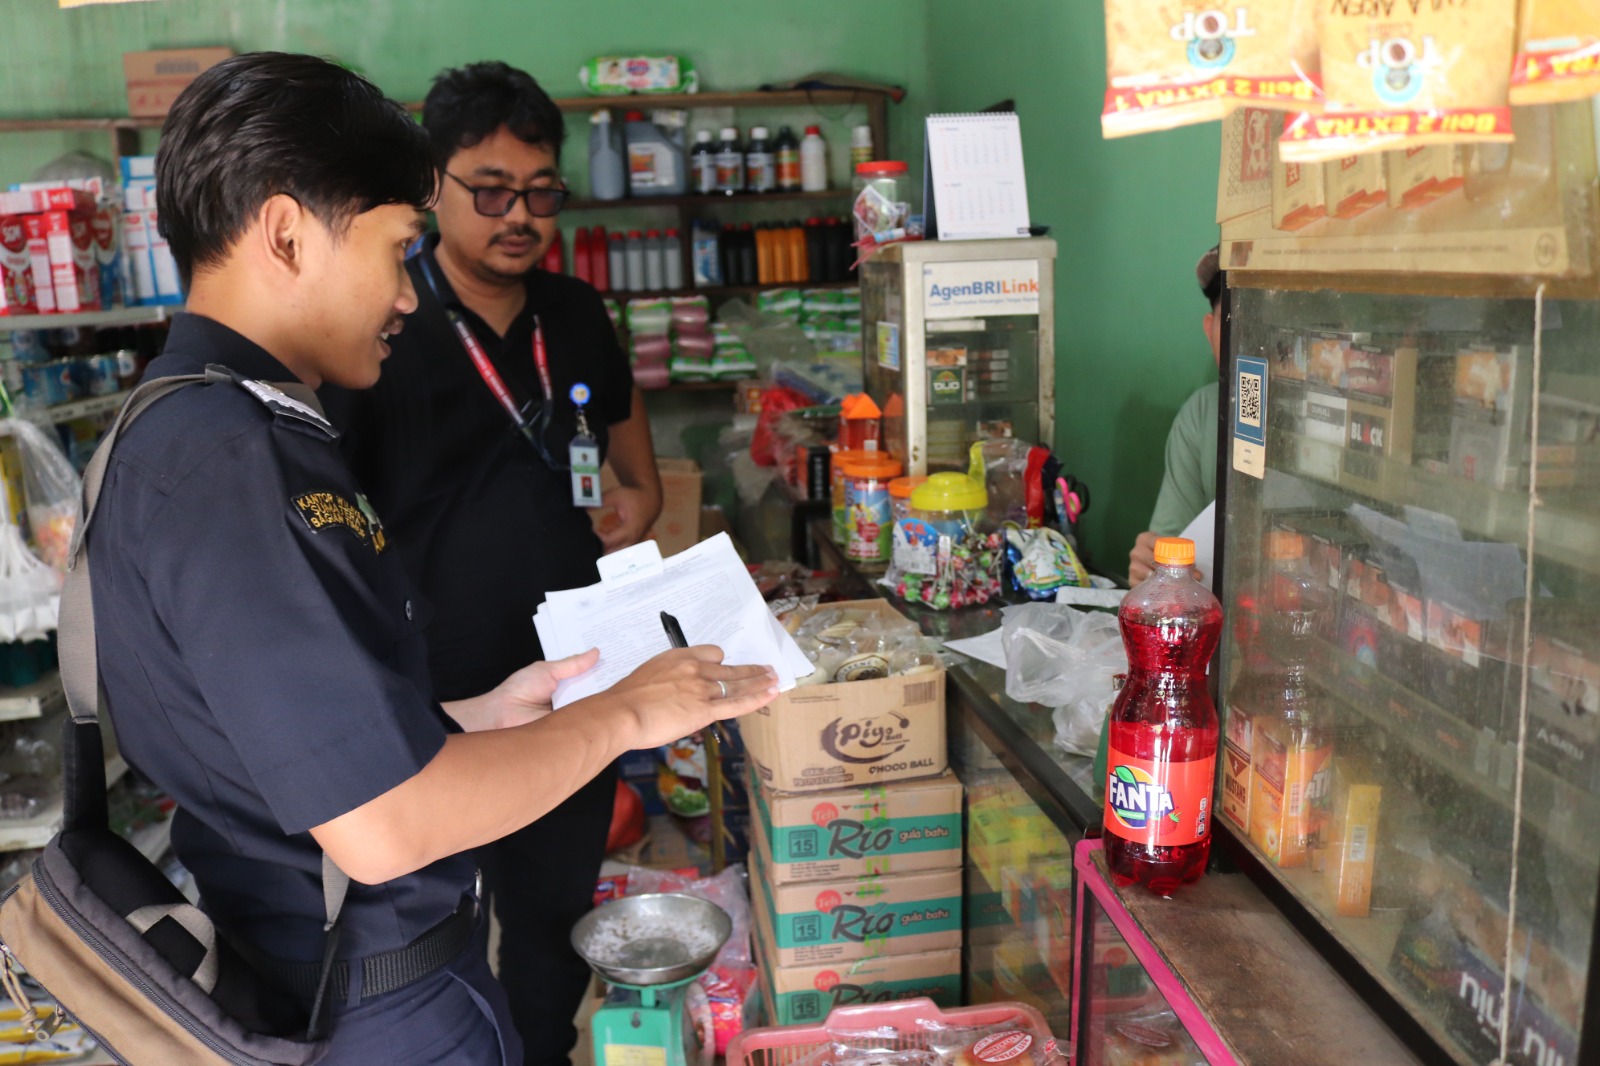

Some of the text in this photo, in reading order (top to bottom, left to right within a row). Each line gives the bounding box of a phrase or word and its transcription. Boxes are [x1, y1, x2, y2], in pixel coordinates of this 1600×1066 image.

[1169, 8, 1256, 41] TOP
[1356, 36, 1442, 71] TOP
[1115, 79, 1313, 112] Beli 2 EXTRA 1
[1293, 114, 1496, 139] Beli 2 EXTRA 1
[297, 492, 333, 511] KANTOR
[868, 758, 934, 774] CHOCO BALL
[1109, 773, 1173, 812] FANTA
[1225, 772, 1246, 804] MUSTANG
[793, 818, 948, 859] 15 Rio gula batu
[798, 904, 949, 942] 15 Rio gula batu
[796, 1003, 816, 1014] 15
